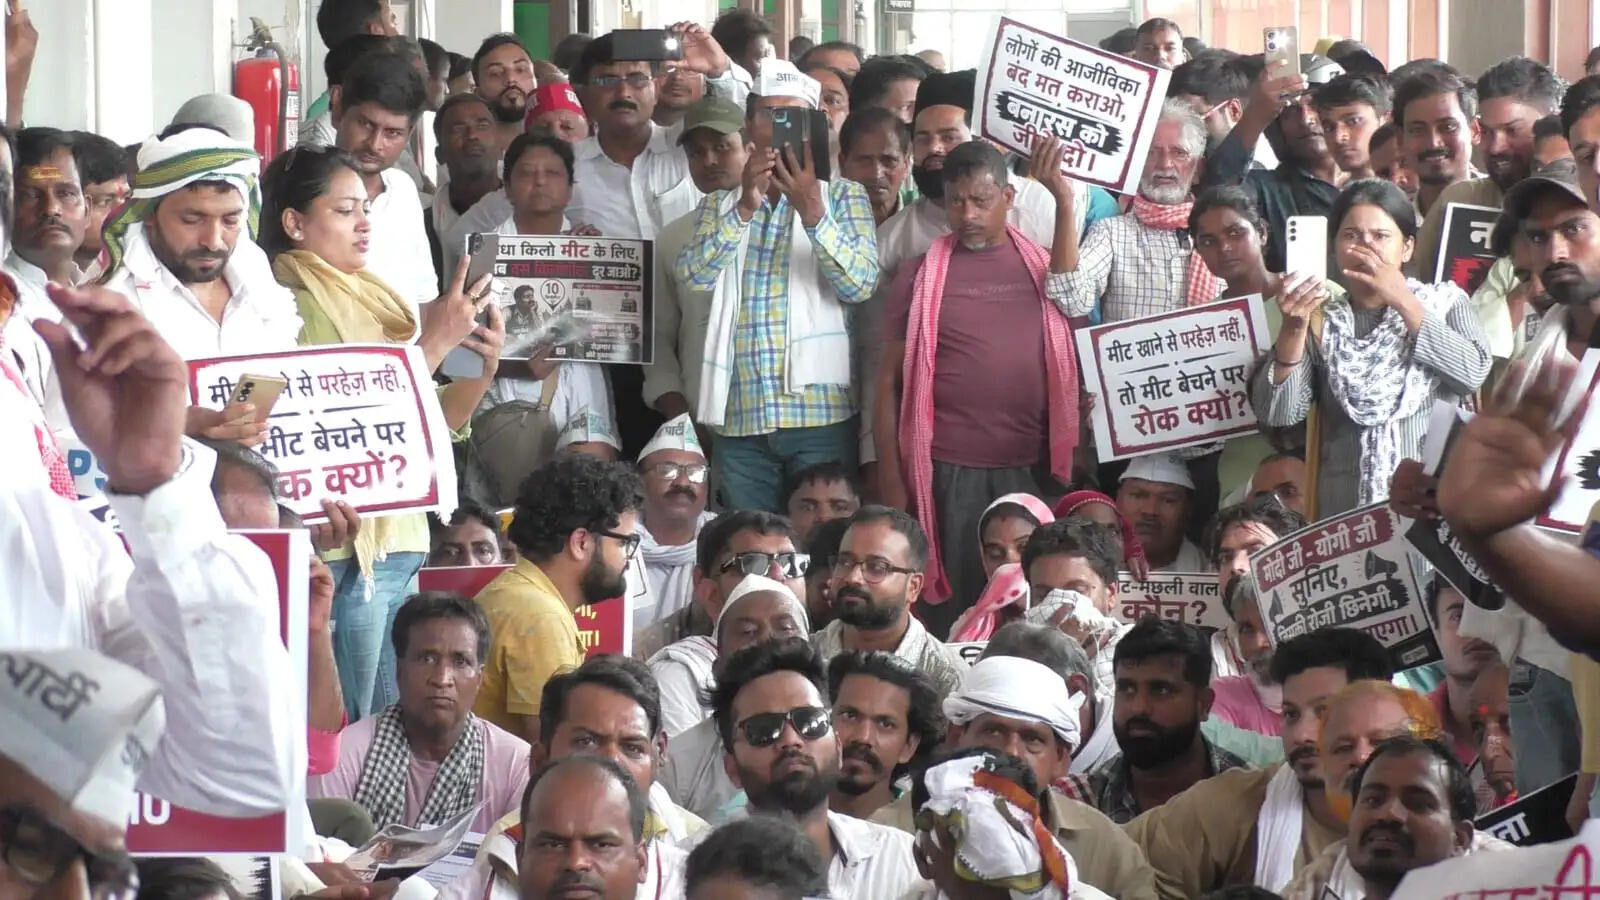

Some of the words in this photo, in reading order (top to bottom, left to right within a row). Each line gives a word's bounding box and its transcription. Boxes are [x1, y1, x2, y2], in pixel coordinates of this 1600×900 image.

[1005, 34, 1038, 62] लोगों
[1040, 46, 1062, 70] की
[1064, 58, 1141, 96] आजीविका
[1006, 60, 1032, 88] बंद
[1034, 72, 1063, 97] मत
[1067, 84, 1127, 122] कराओ,
[1006, 94, 1078, 138] बनारस
[1079, 121, 1110, 148] को
[496, 243, 516, 257] धा
[520, 241, 556, 257] किलो
[560, 240, 590, 258] मीट
[593, 242, 606, 258] के
[610, 243, 640, 261] लिए,
[545, 282, 560, 295] 10
[1106, 340, 1133, 363] मीट
[1136, 332, 1164, 359] खाने
[1165, 329, 1179, 352] से
[1180, 324, 1217, 350] परहेज़
[1218, 316, 1246, 342] नहीं,
[208, 376, 236, 408] मी
[297, 369, 314, 397] से
[318, 366, 367, 398] परहेज़
[369, 363, 407, 393] नहीं,
[1117, 381, 1137, 406] तो
[1140, 375, 1173, 401] मीट
[1176, 365, 1218, 395] बेचने
[1220, 364, 1246, 386] पर
[1131, 404, 1180, 437] रोक
[1184, 389, 1249, 426] क्यों?
[260, 426, 305, 459] मीट
[312, 418, 368, 452] बेचने
[374, 421, 407, 446] पर
[322, 451, 409, 496] क्यों?
[1262, 551, 1285, 583] मोदी
[1286, 542, 1304, 569] जी
[1314, 523, 1351, 557] योगी
[1353, 514, 1378, 543] जी
[1117, 577, 1184, 595] ट-मछली
[1289, 563, 1348, 609] सुनिए,
[1339, 584, 1399, 621] छिनेगी,
